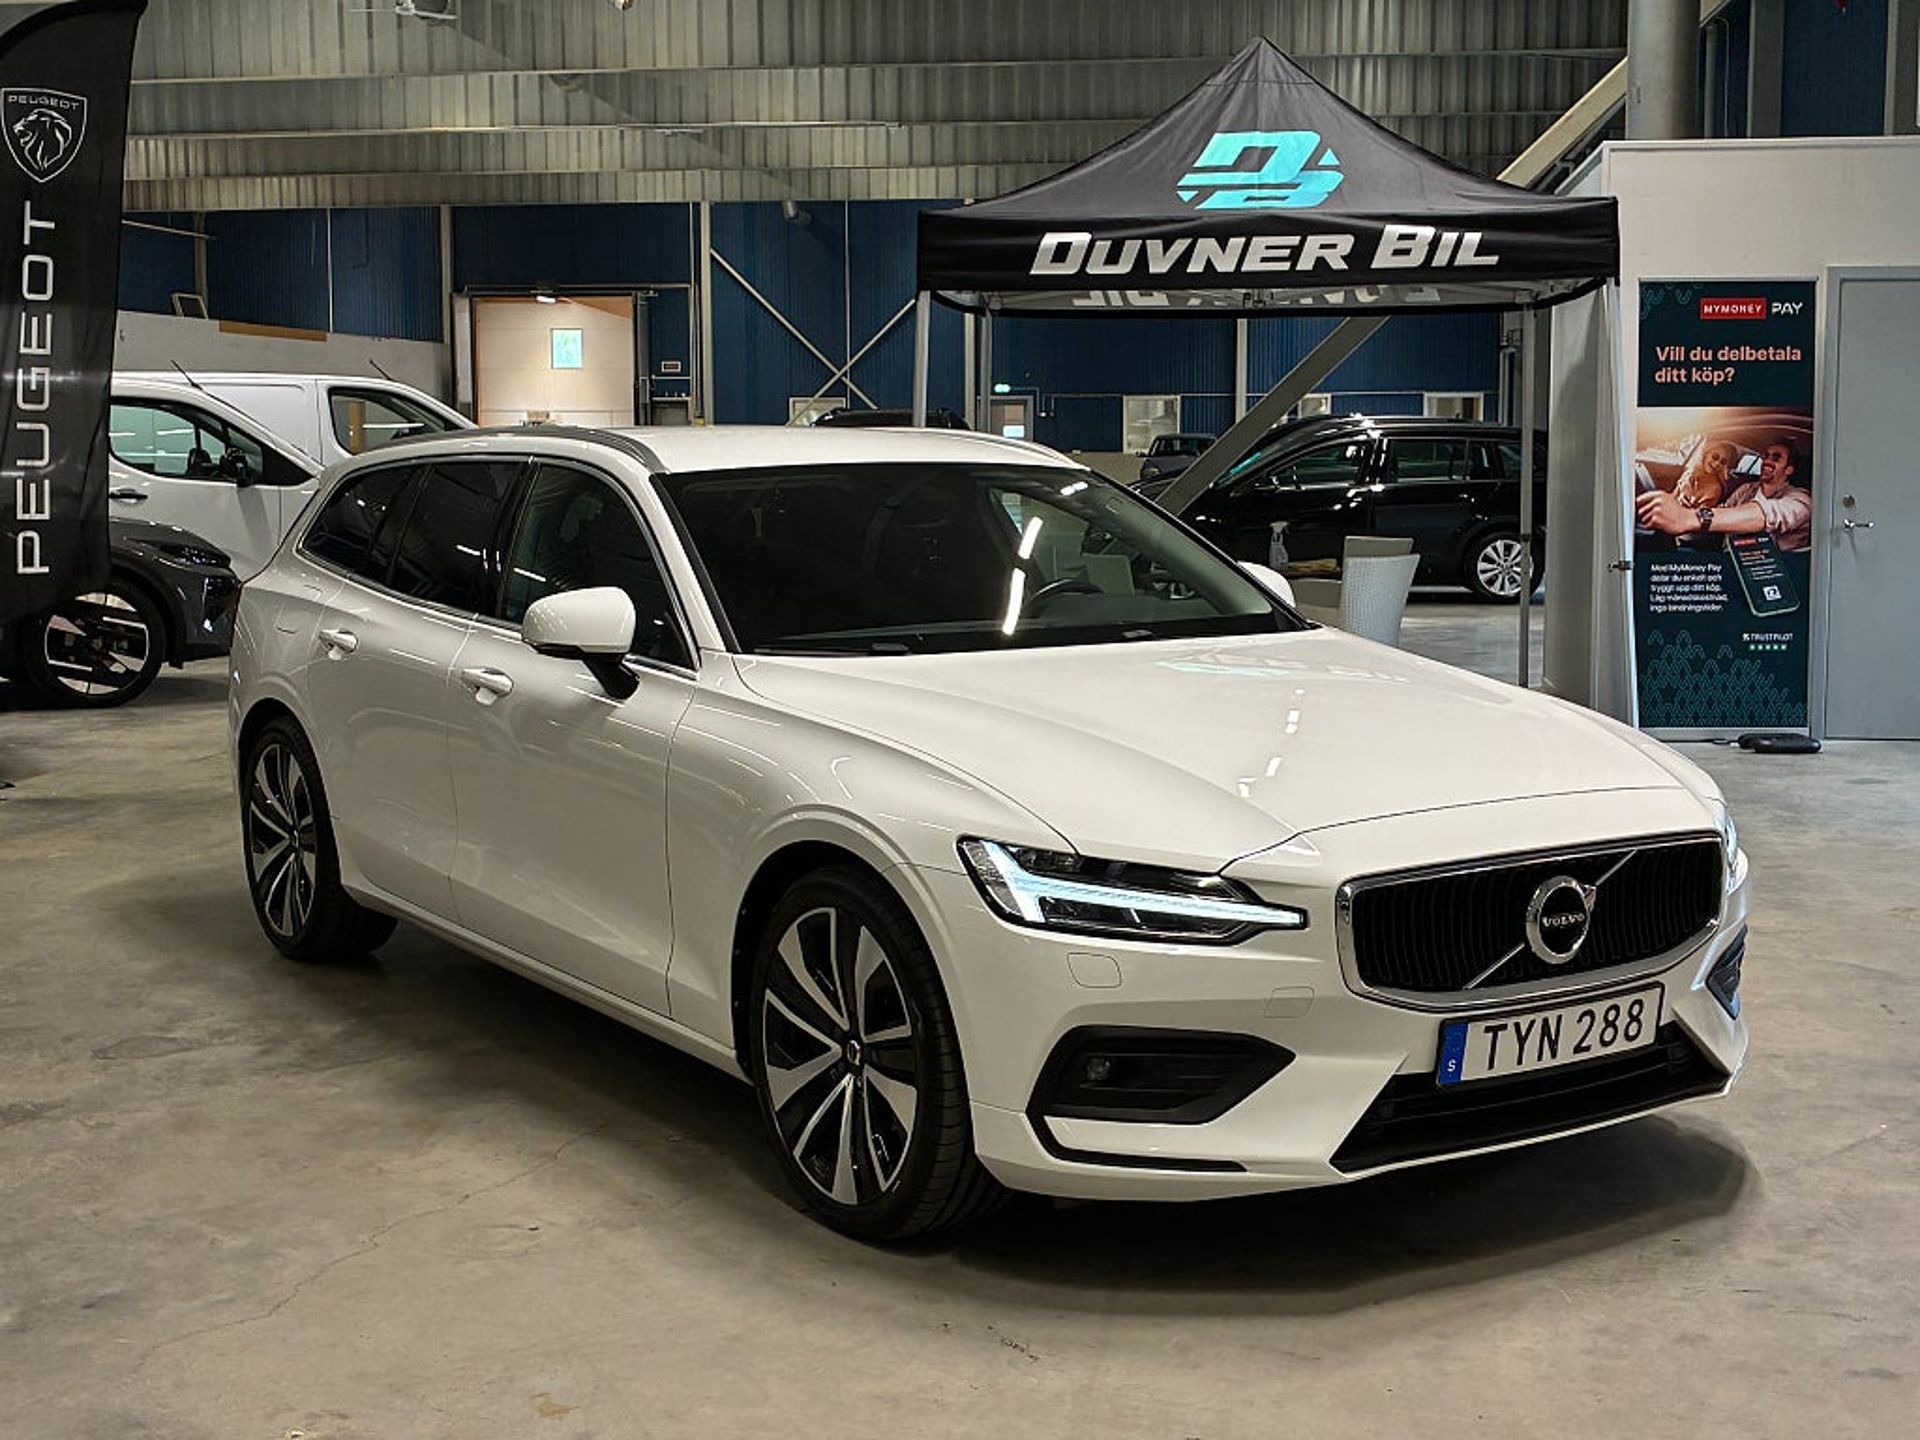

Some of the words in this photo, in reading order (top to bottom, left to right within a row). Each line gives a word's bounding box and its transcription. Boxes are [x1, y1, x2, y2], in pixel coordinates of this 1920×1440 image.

[9, 94, 79, 110] PEUGEOT
[1703, 304, 1762, 314] MYMONEY
[1771, 301, 1803, 315] PAY
[1655, 346, 1685, 362] Vill
[1690, 346, 1712, 362] du
[1717, 346, 1802, 362] delbetala
[1655, 367, 1686, 383] ditt
[1691, 366, 1735, 386] köp?
[16, 200, 56, 575] PEUGEOT
[1542, 913, 1585, 928] VOLVO
[1447, 1059, 1456, 1073] S
[1484, 1014, 1563, 1071] TYN
[1572, 999, 1644, 1055] 288
